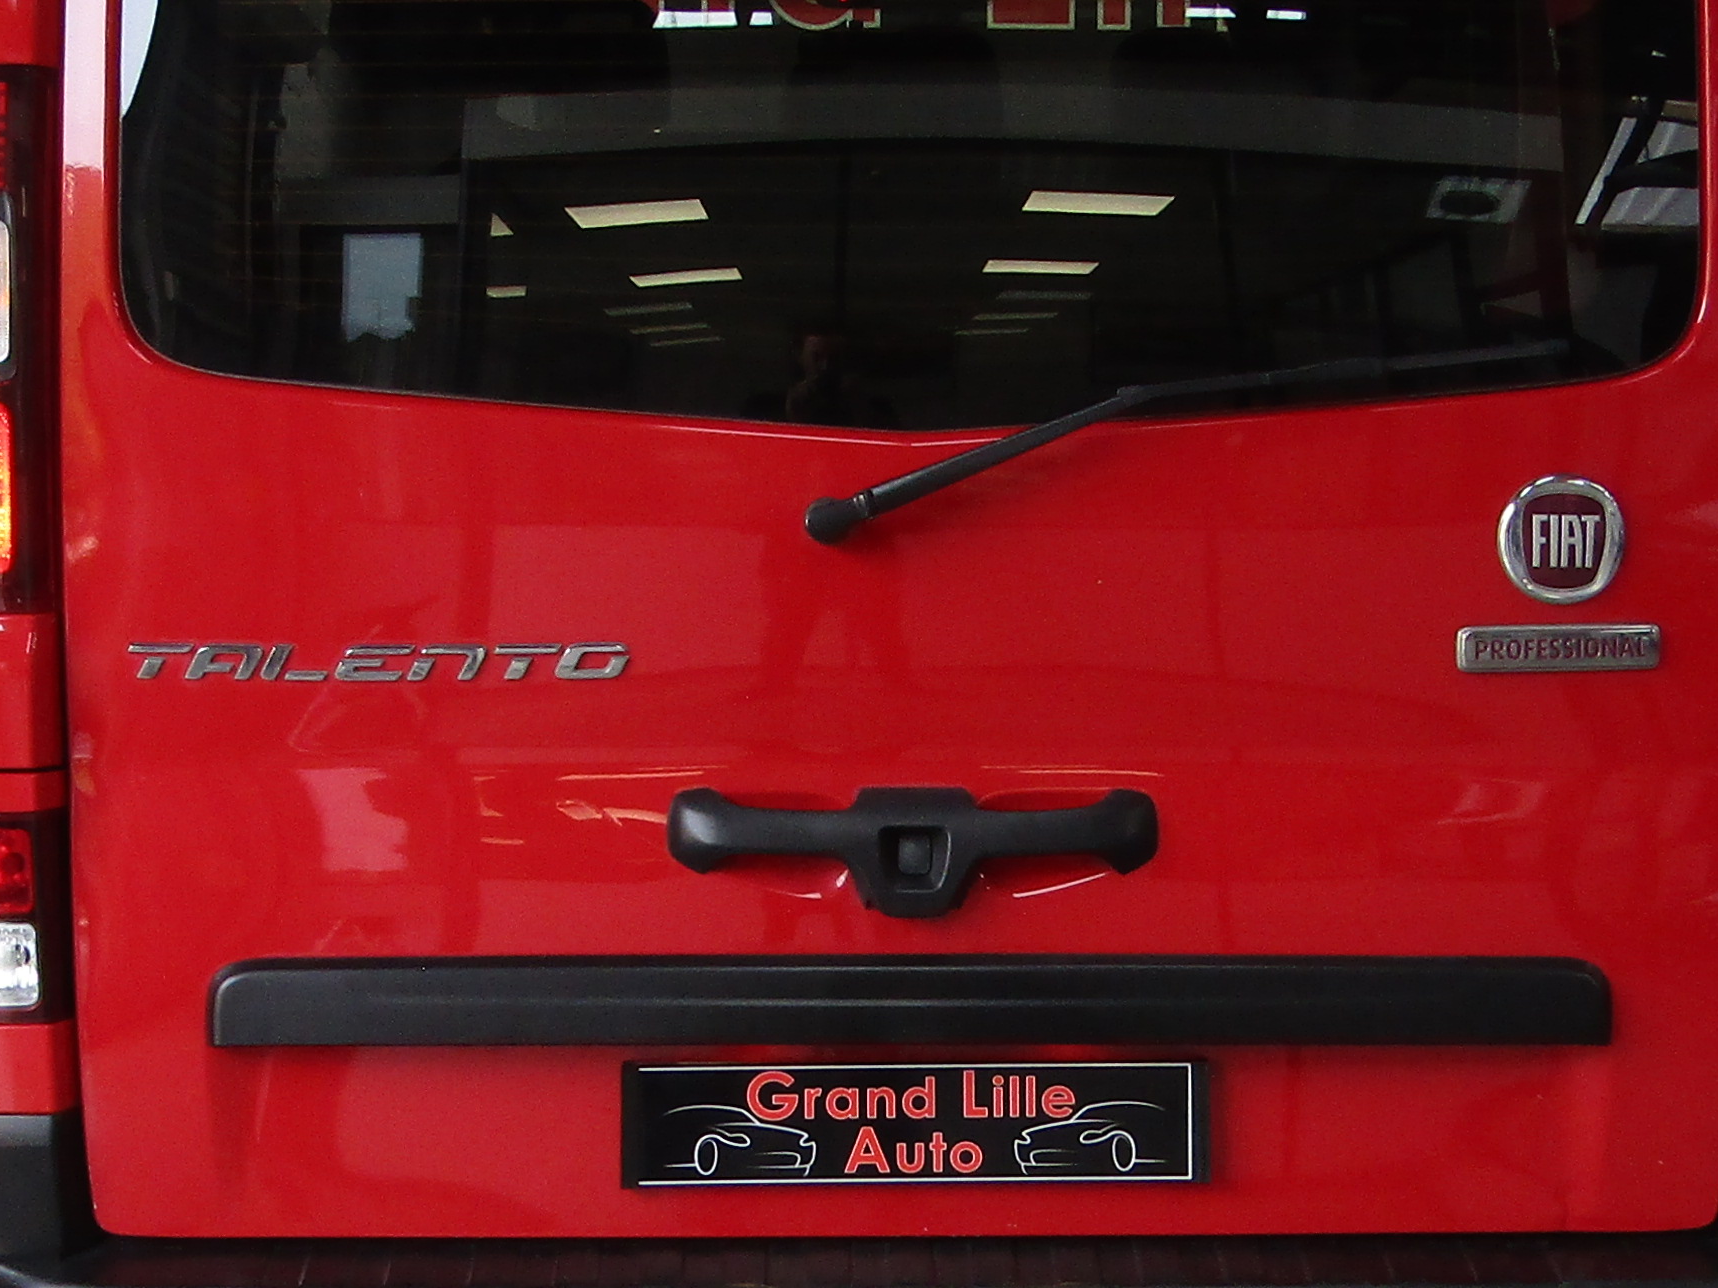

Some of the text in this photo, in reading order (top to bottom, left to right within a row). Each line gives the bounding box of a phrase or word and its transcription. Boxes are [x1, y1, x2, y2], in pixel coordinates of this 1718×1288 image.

[1531, 513, 1602, 569] FIAT
[126, 640, 631, 682] TALENTO
[1473, 636, 1647, 663] PROFESSIONAL
[745, 1068, 1076, 1123] Grand Lille
[843, 1124, 985, 1175] Auto
